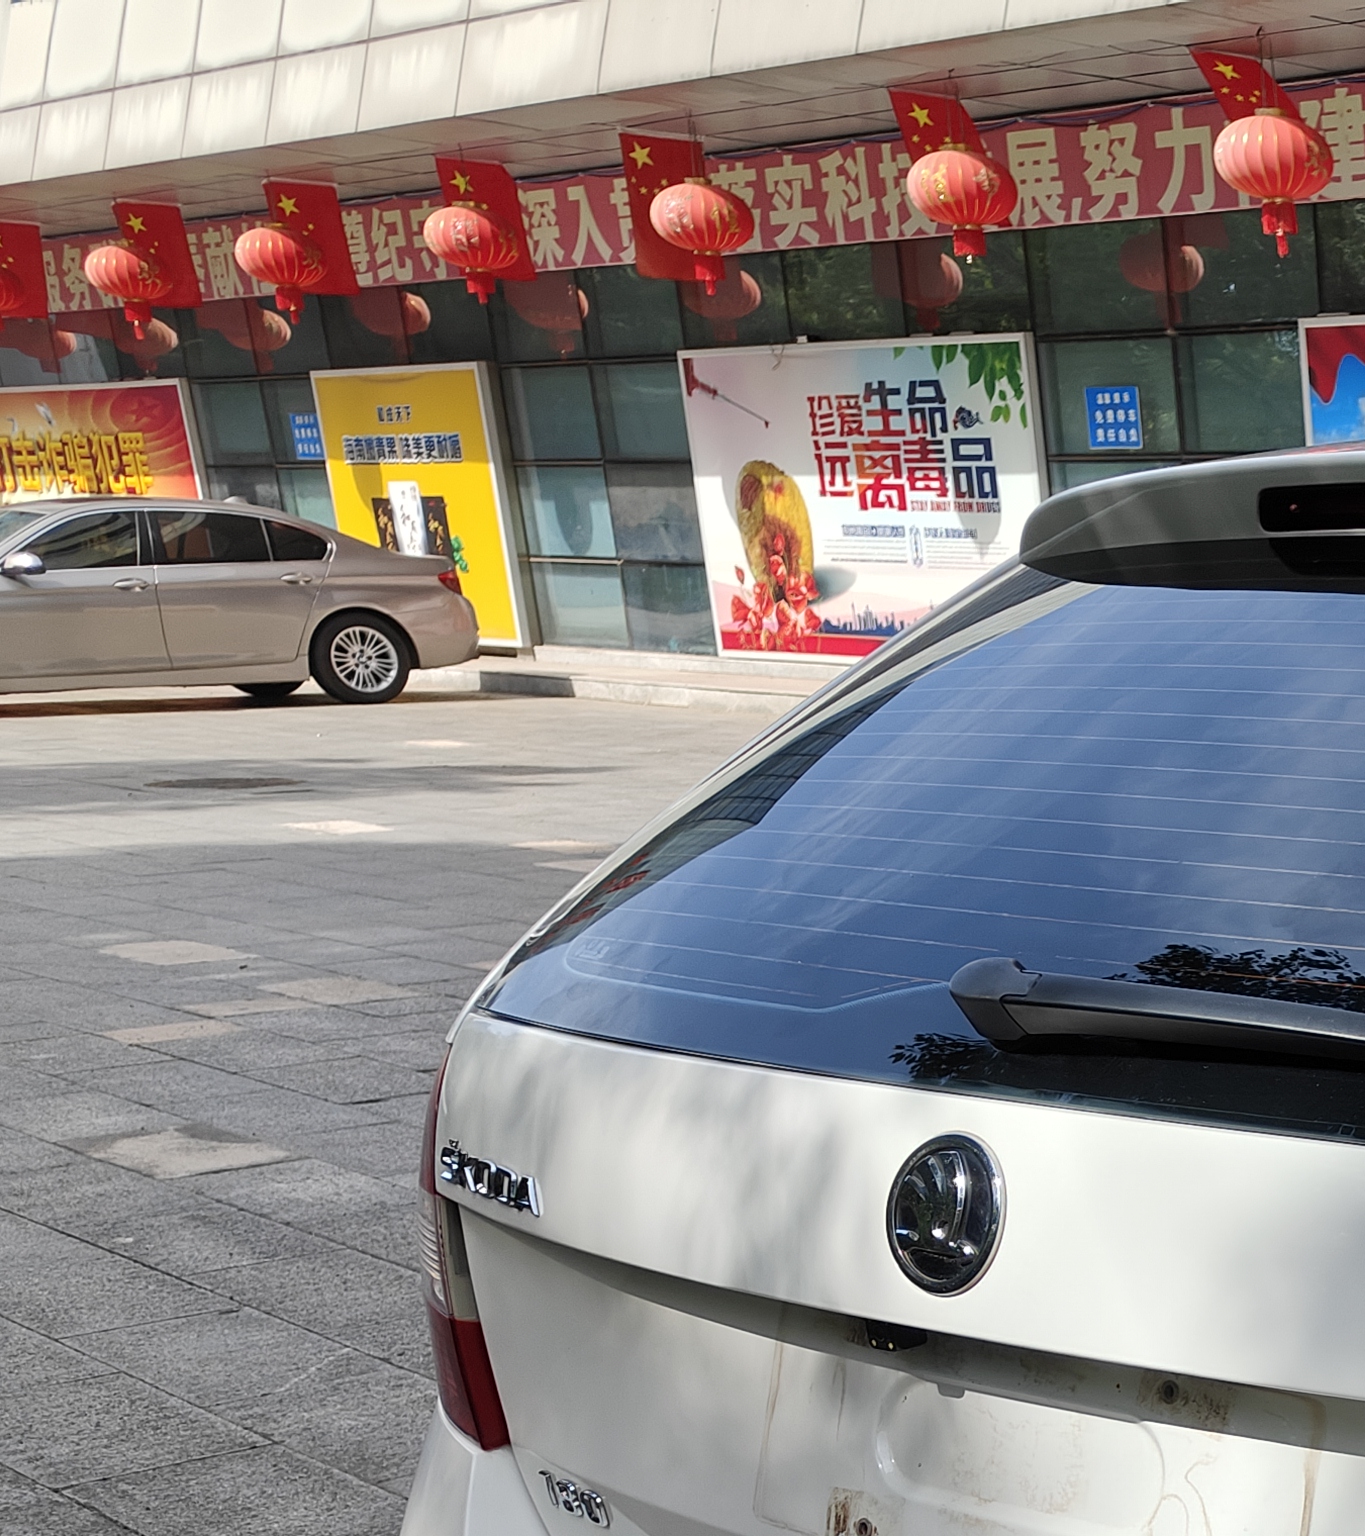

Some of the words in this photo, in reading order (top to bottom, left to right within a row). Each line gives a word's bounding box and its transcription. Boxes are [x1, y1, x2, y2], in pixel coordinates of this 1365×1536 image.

[807, 379, 949, 438] 珍爱生命
[813, 437, 1001, 511] 远离毒品
